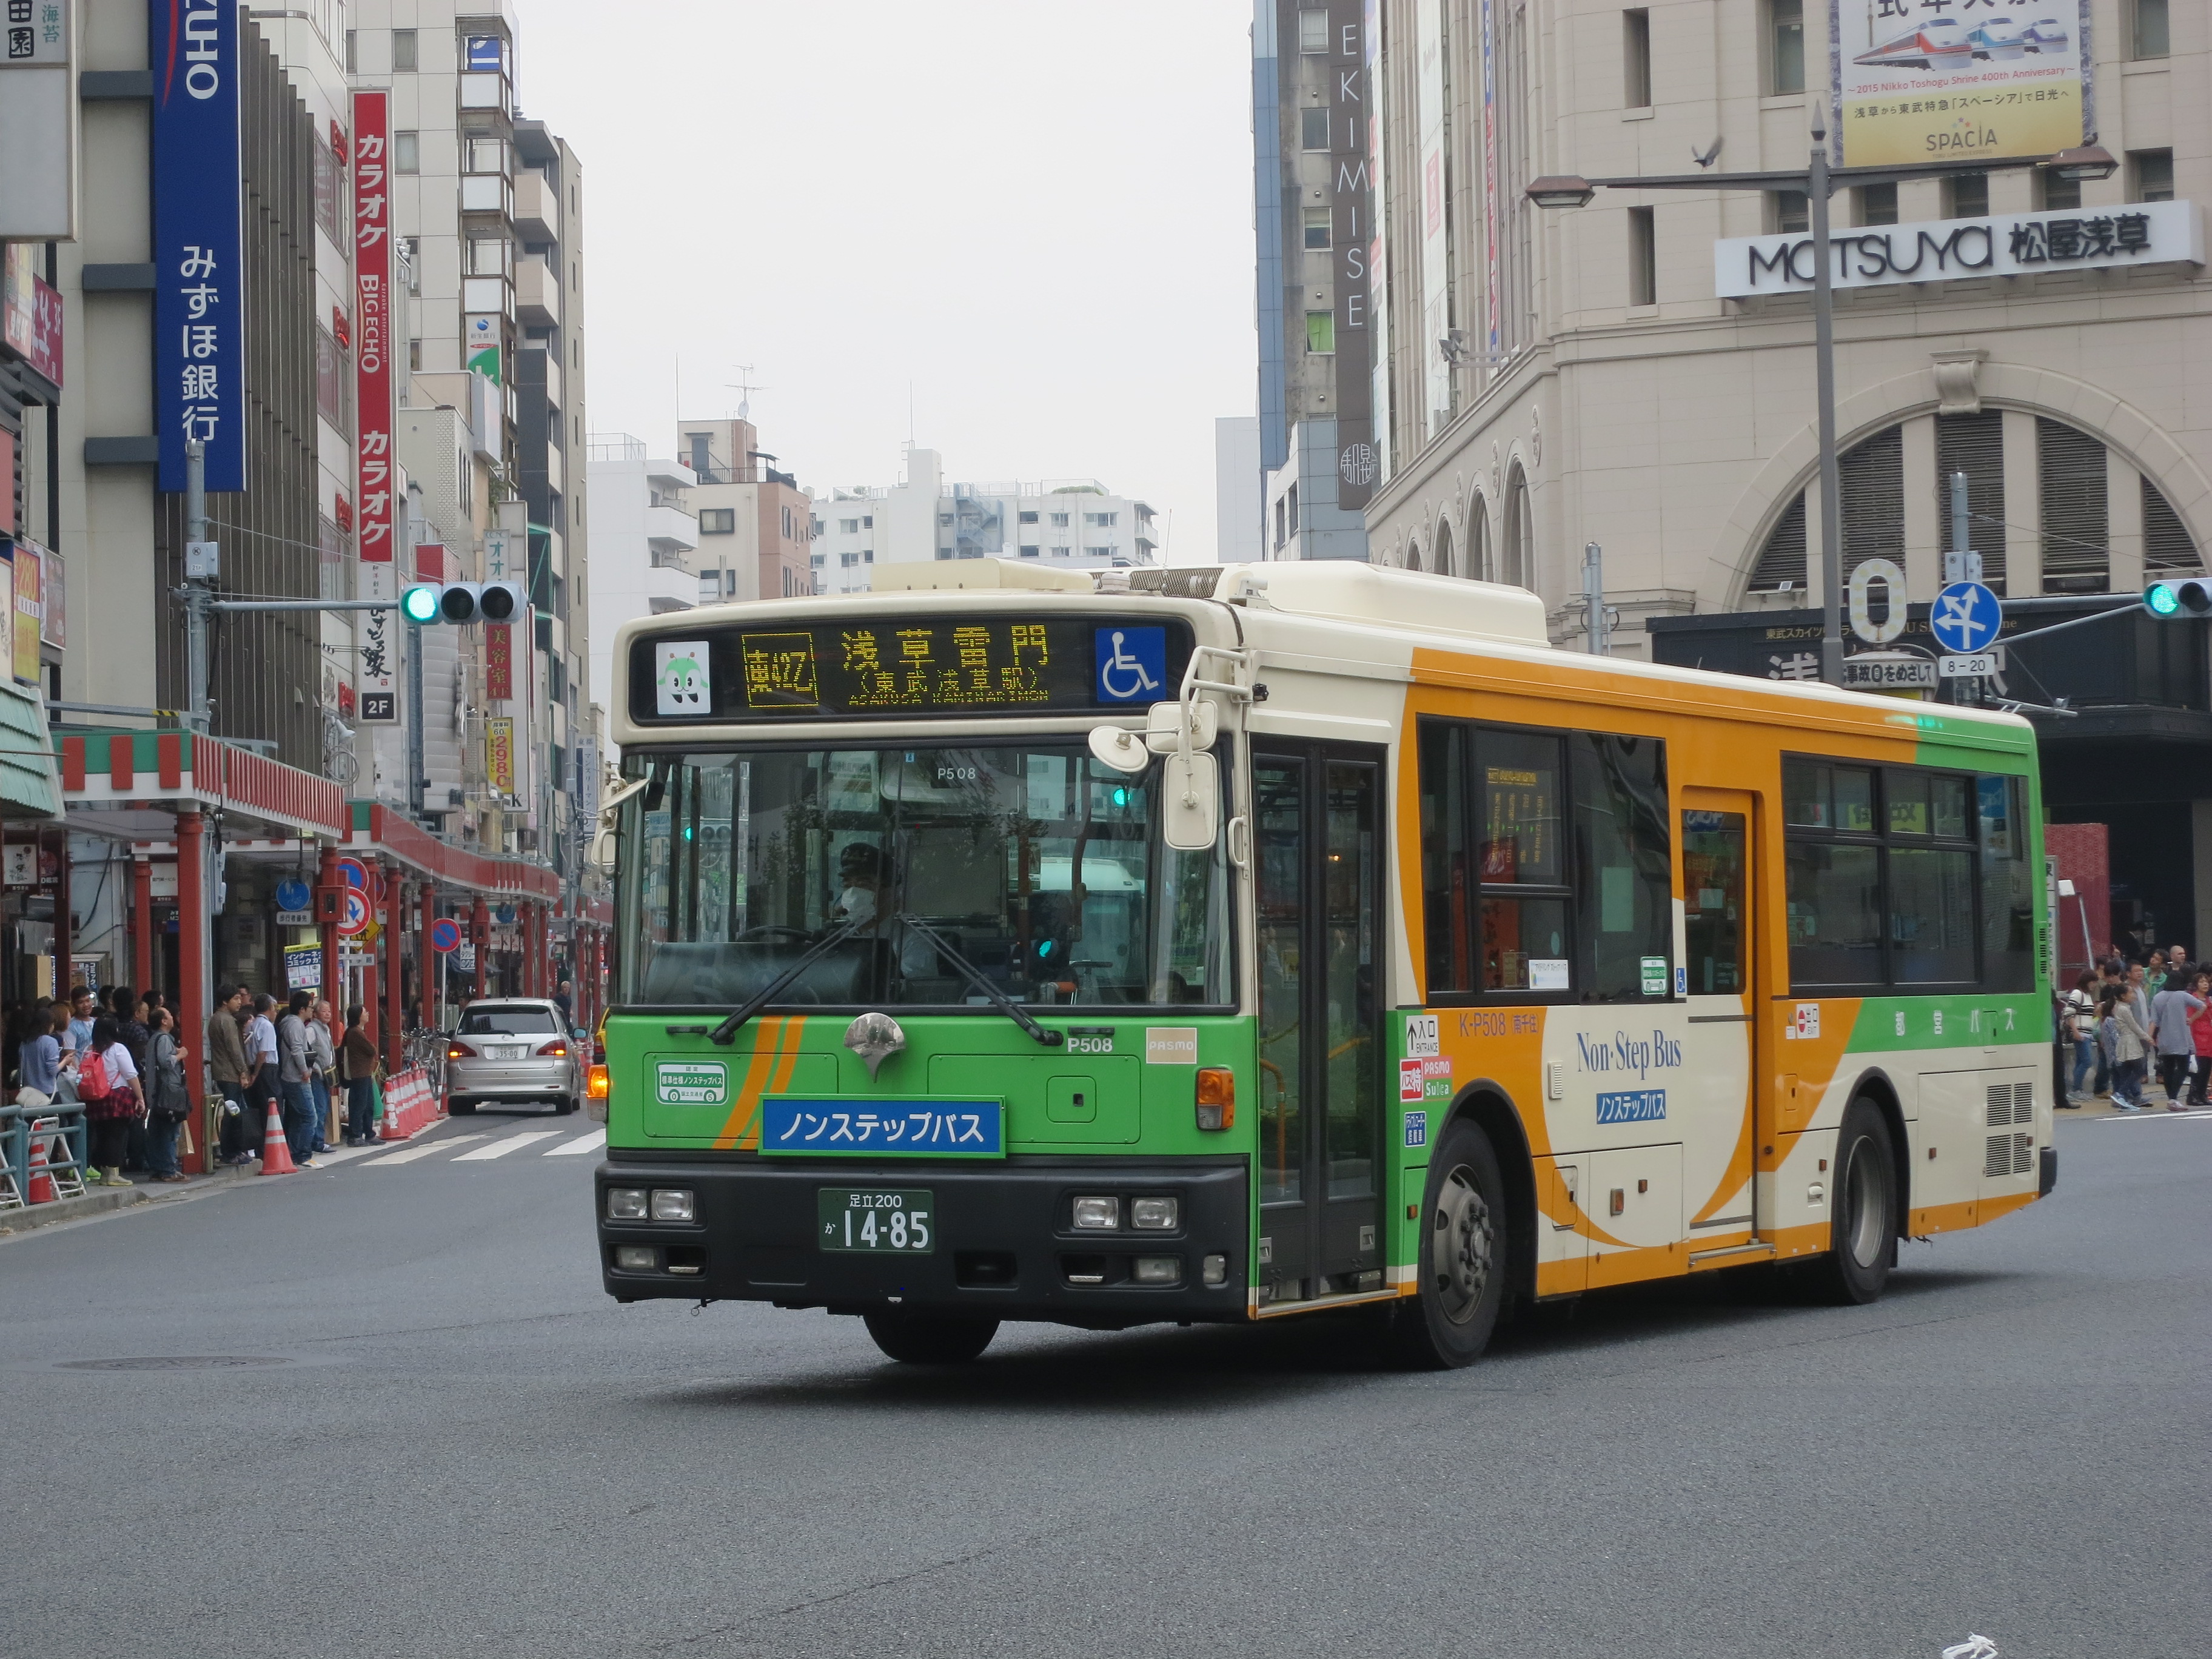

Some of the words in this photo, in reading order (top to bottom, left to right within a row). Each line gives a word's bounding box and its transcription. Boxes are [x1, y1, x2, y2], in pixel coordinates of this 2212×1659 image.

[1881, 82, 1908, 91] Nikko
[1910, 79, 1948, 88] Toshogu
[1951, 76, 1979, 84] Shrine
[1981, 72, 2009, 81] 400th
[1854, 89, 2069, 118] 浅草から東武特急「スペーシア」で日光へ
[1926, 121, 1998, 151] SPACIA
[1338, 24, 1370, 326] EKIMISE
[357, 133, 387, 249] カラオケ
[2009, 213, 2151, 263] 松屋浅草
[360, 275, 379, 312] BIG
[180, 245, 220, 441] みずほ銀行
[361, 317, 380, 374] ECHO
[360, 430, 392, 545] カラオケ
[489, 541, 504, 581] オオ
[492, 629, 506, 684] 美容室
[841, 625, 1048, 671] 浅草雷門
[489, 687, 509, 697] 4F
[367, 700, 389, 714] 2F
[937, 767, 976, 780] P508
[280, 914, 307, 922] 歩行者優先
[287, 957, 321, 967] コミックカ
[1418, 1020, 1436, 1039] 入口
[1459, 1012, 1506, 1037] K-P508
[1067, 1037, 1113, 1053] P508
[1148, 1041, 1195, 1051] PASMO
[1416, 1042, 1438, 1053] ENTRANCE
[1652, 1030, 1681, 1067] Bus
[1425, 1061, 1450, 1075] PASMO
[1426, 1082, 1449, 1096] Suica
[1597, 1093, 1666, 1122] ノンステップバス
[780, 1111, 984, 1143] ノンステップバス
[824, 1222, 836, 1235] か
[845, 1210, 929, 1248] 14-85
